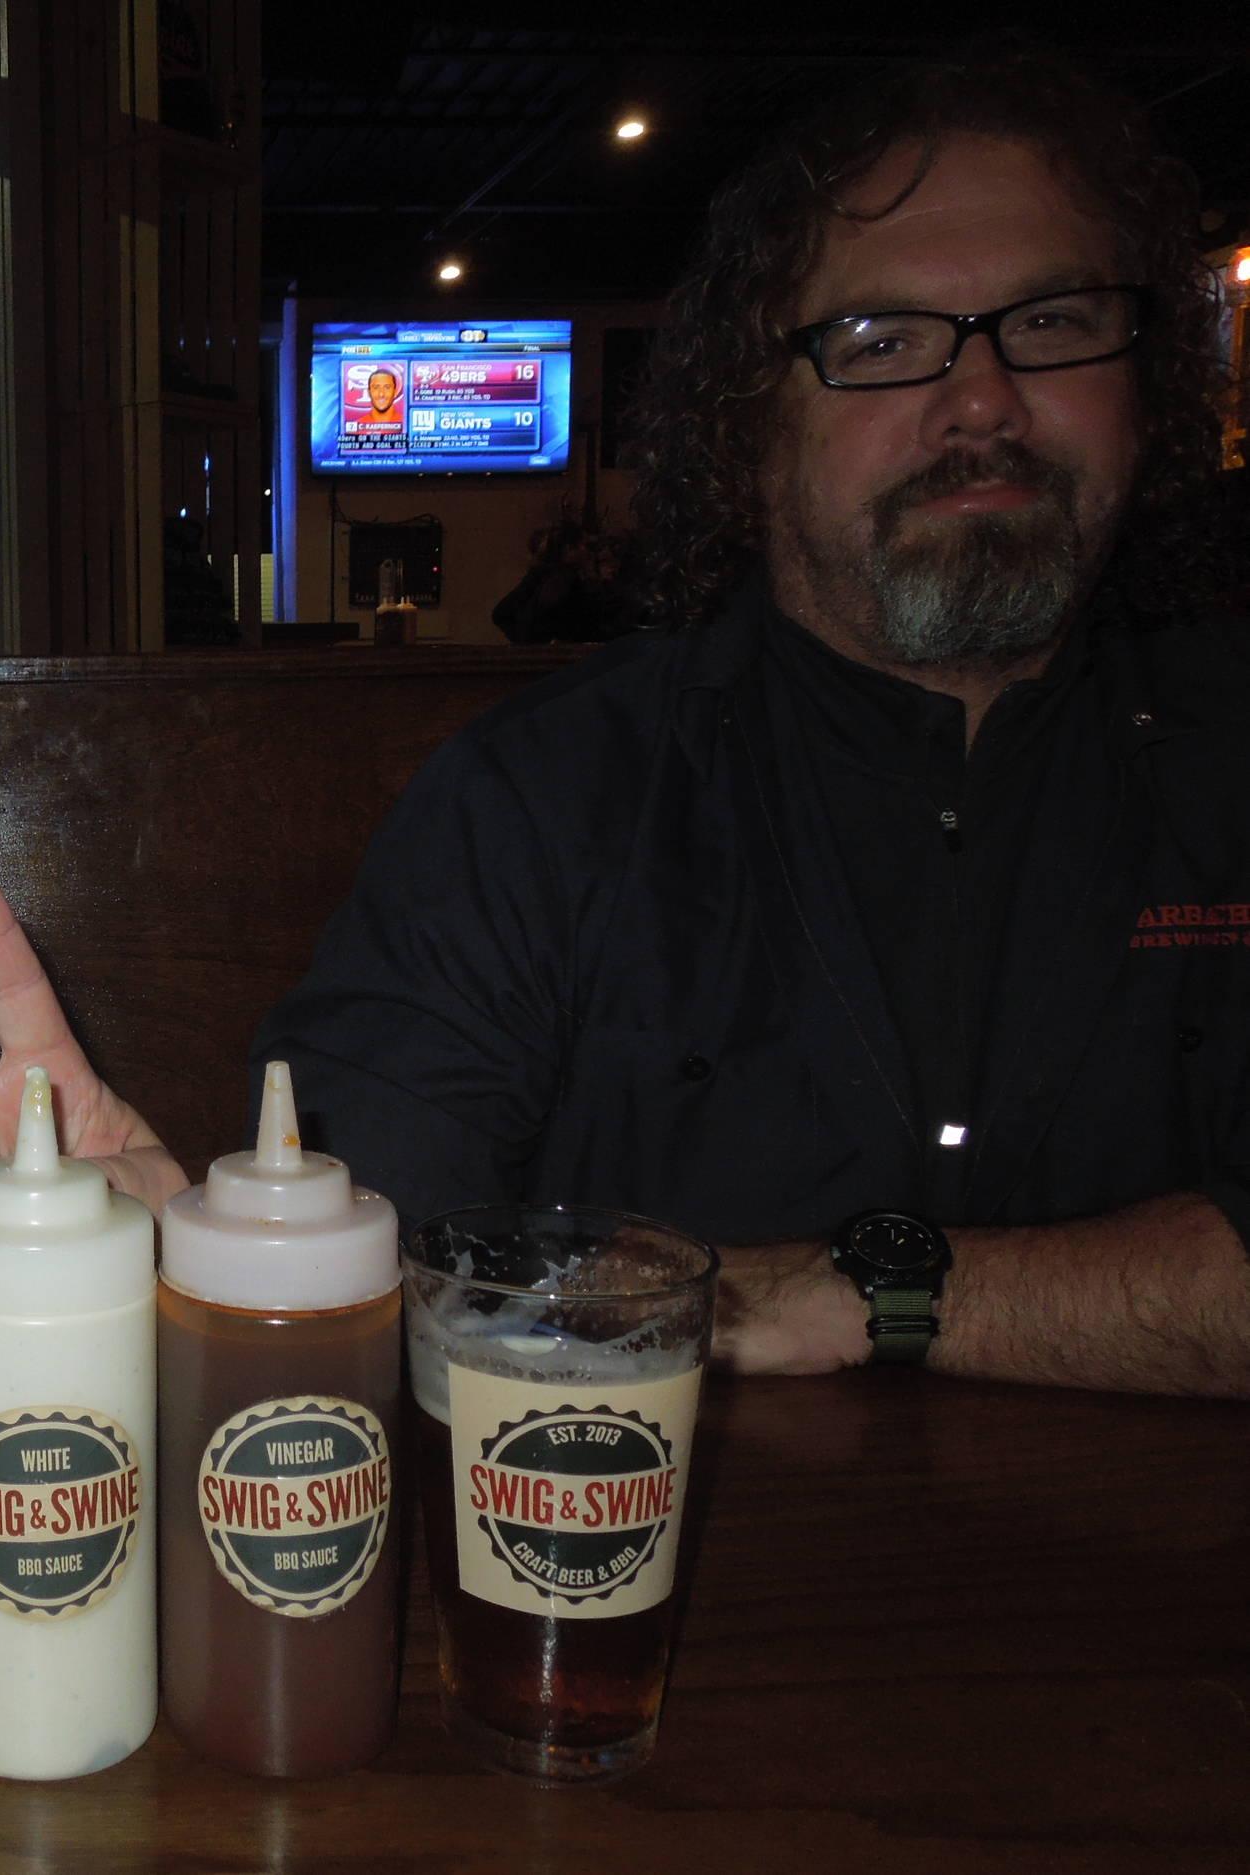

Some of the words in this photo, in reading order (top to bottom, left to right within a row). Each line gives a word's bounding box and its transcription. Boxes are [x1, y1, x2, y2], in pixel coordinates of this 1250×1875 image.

[440, 371, 486, 383] 49ERS
[515, 364, 534, 380] 16
[440, 417, 492, 430] GIANTS
[514, 411, 533, 426] 10
[547, 1424, 582, 1446] EST.
[585, 1424, 622, 1446] 2013
[20, 1446, 72, 1473] WHITE
[266, 1436, 335, 1466] VINEGAR
[29, 1499, 48, 1530] &
[50, 1466, 140, 1536] SWINE
[203, 1475, 282, 1531] SWIG
[286, 1492, 304, 1523] &
[306, 1455, 388, 1528] SWINE
[470, 1463, 555, 1526] SWIG
[559, 1490, 578, 1521] &
[582, 1467, 678, 1529] SWINE
[17, 1558, 43, 1577] BBQ
[45, 1553, 84, 1576] SAUCE
[273, 1552, 300, 1571] BBQ
[301, 1546, 339, 1570] SAUCE
[512, 1541, 559, 1580] CRAFT
[558, 1568, 594, 1587] BEER
[598, 1565, 611, 1583] &
[610, 1546, 640, 1576] BBQ
